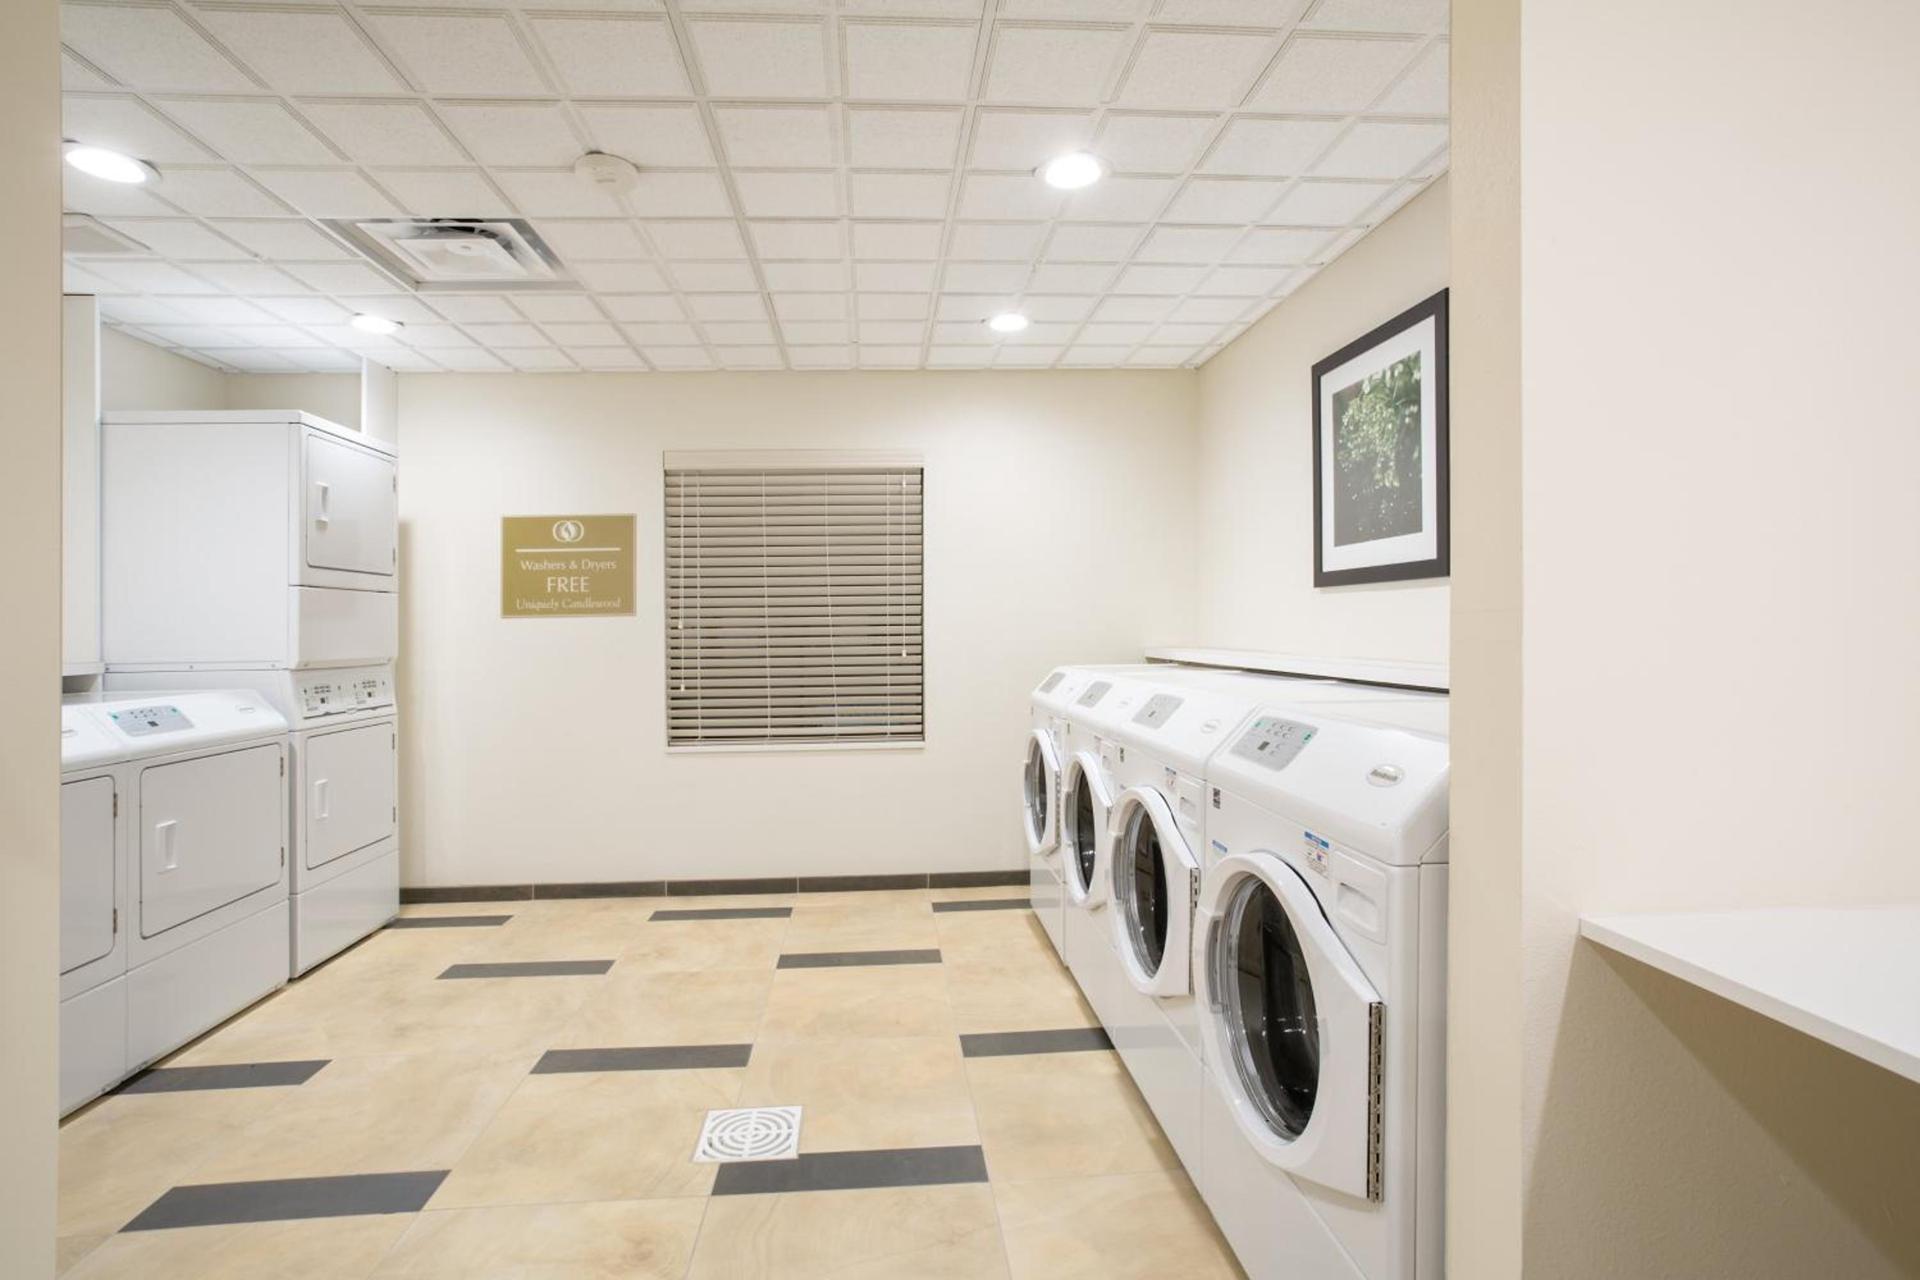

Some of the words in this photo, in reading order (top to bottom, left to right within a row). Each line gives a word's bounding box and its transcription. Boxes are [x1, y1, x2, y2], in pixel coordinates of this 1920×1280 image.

[520, 559, 566, 571] Washers
[568, 559, 578, 570] &
[581, 557, 617, 572] Dryers
[546, 576, 590, 593] FREE
[516, 598, 559, 611] Uniquely
[561, 596, 621, 609] Candlewood
